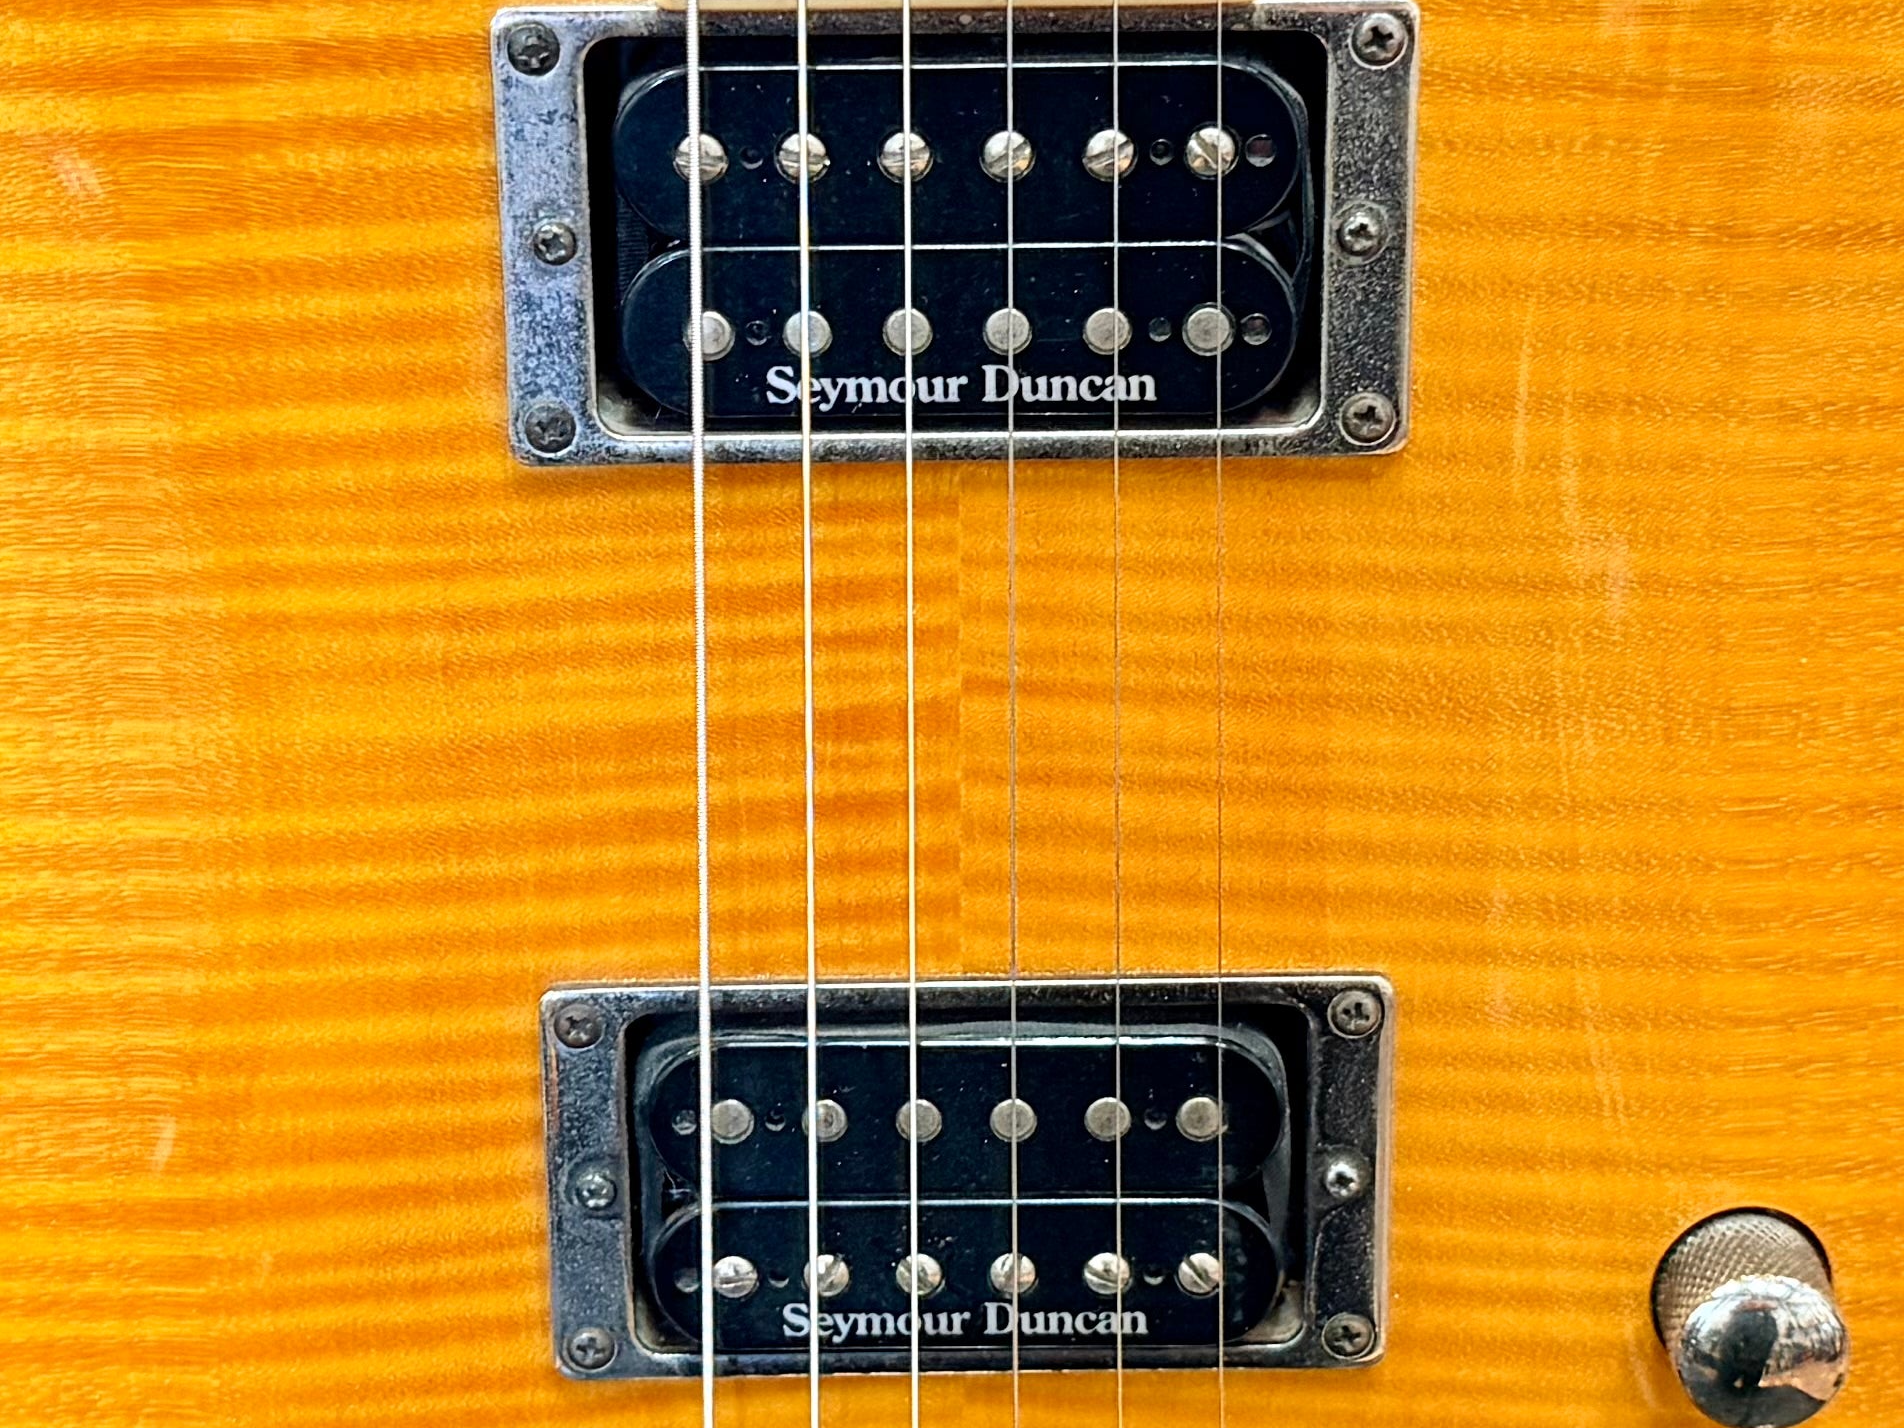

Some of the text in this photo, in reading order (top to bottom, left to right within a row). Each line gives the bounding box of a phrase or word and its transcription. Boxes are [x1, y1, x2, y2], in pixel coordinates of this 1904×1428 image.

[766, 363, 1158, 413] Seymour Duncan
[781, 1301, 1149, 1343] Seymour Duncan
